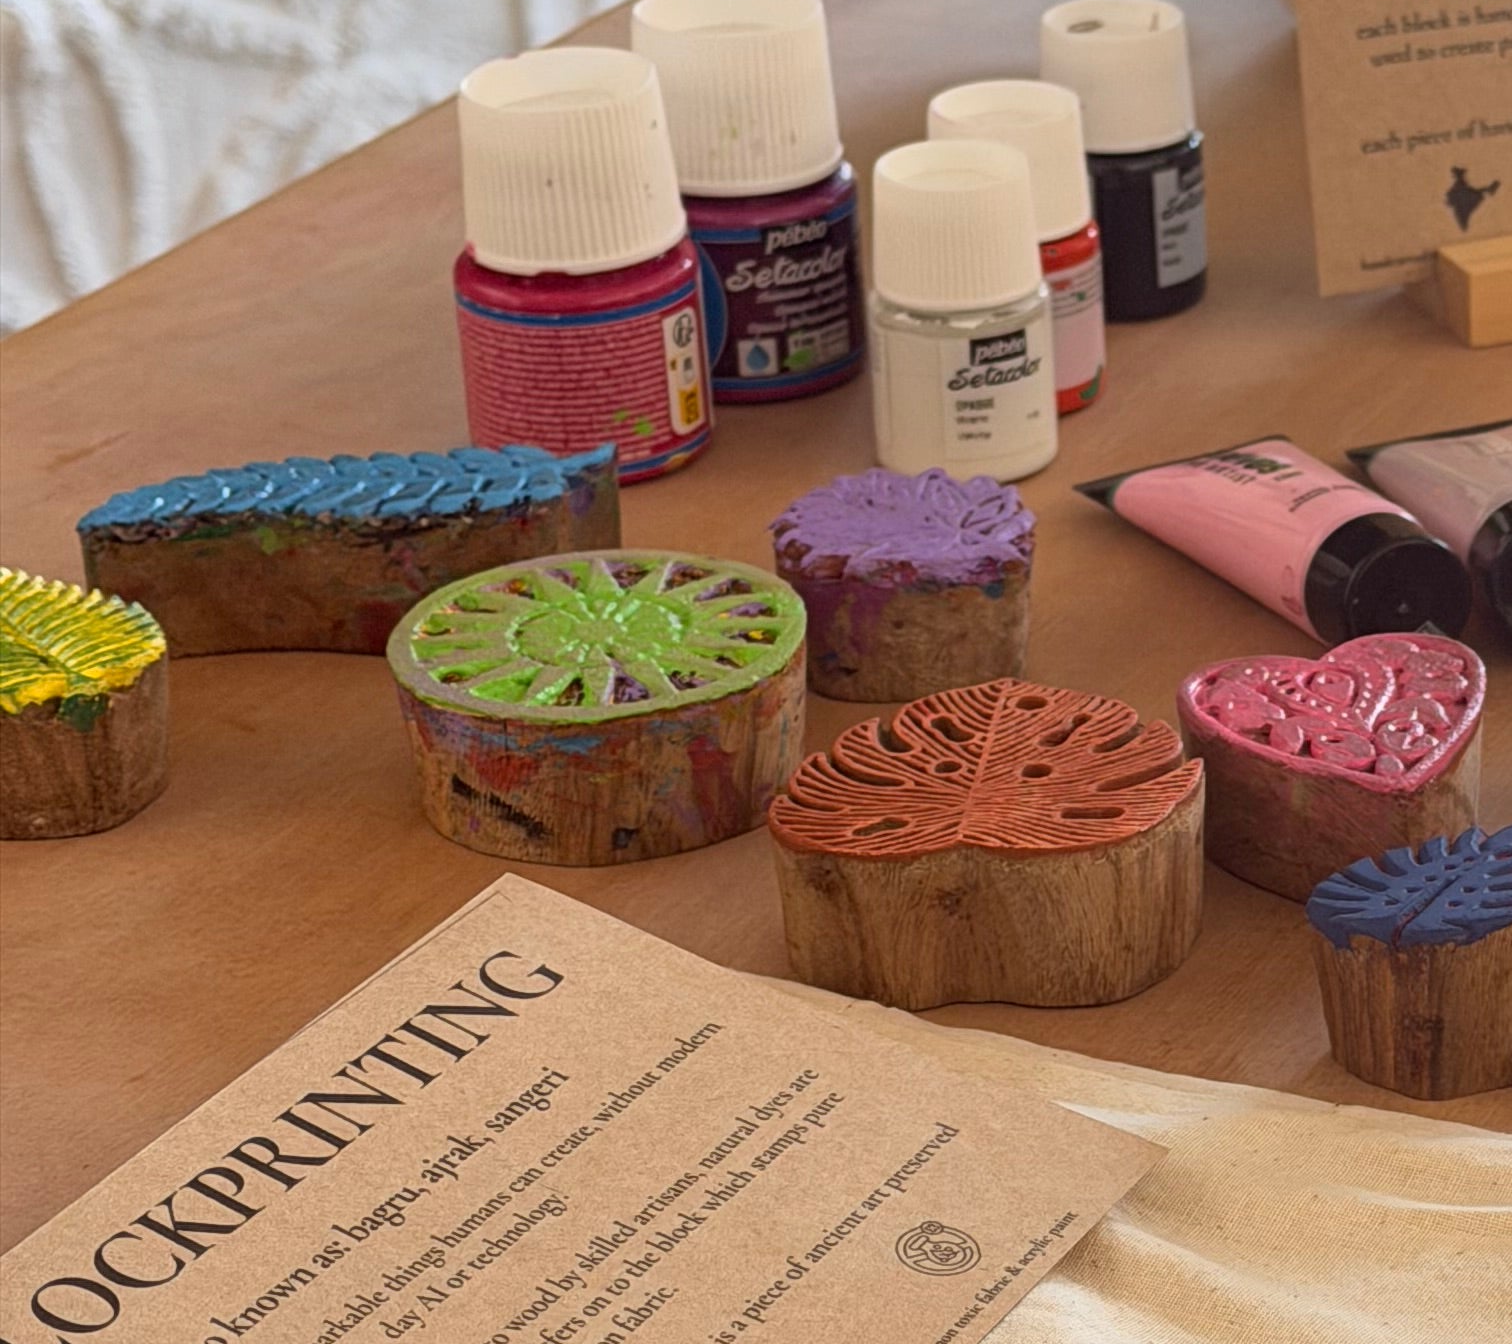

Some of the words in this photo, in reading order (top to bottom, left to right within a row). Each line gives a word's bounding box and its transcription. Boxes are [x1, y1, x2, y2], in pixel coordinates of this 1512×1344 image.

[484, 1065, 571, 1134] sangeri
[380, 1246, 446, 1293] things
[429, 1191, 513, 1249] humans
[508, 1167, 546, 1194] can
[539, 1125, 603, 1169] create,
[592, 1070, 662, 1123] without
[655, 1022, 724, 1074] modern
[420, 1134, 496, 1184] ajrak,
[503, 1285, 562, 1332] wood
[544, 1269, 587, 1293] by
[574, 1219, 639, 1273] skilled
[632, 1172, 708, 1227] artisans,
[698, 1116, 761, 1170] natural
[748, 1090, 795, 1122] dyes
[788, 1068, 820, 1093] are
[581, 1295, 613, 1318] on
[603, 1276, 632, 1297] to
[621, 1251, 662, 1279] the
[644, 1211, 709, 1254] block
[700, 1169, 757, 1212] which
[750, 1123, 810, 1172] stamps
[802, 1091, 846, 1129] pure
[311, 1240, 352, 1270] as:
[330, 1186, 432, 1243] bagru,
[729, 1319, 749, 1333] a
[741, 1279, 792, 1324] piece
[784, 1254, 811, 1281] of
[803, 1209, 868, 1264] ancient
[860, 1187, 892, 1212] art
[883, 1121, 961, 1194] preserved
[209, 1267, 318, 1338] known
[379, 1308, 427, 1340] day
[415, 1284, 451, 1313] AI
[445, 1268, 473, 1290] or
[466, 1193, 570, 1271] technology.
[610, 1286, 680, 1334] fabric.
[953, 1303, 985, 1330] toxic
[973, 1275, 1013, 1305] fabric
[1003, 1265, 1024, 1278] &
[1017, 1235, 1054, 1267] acrylic
[1048, 1211, 1079, 1240] paint
